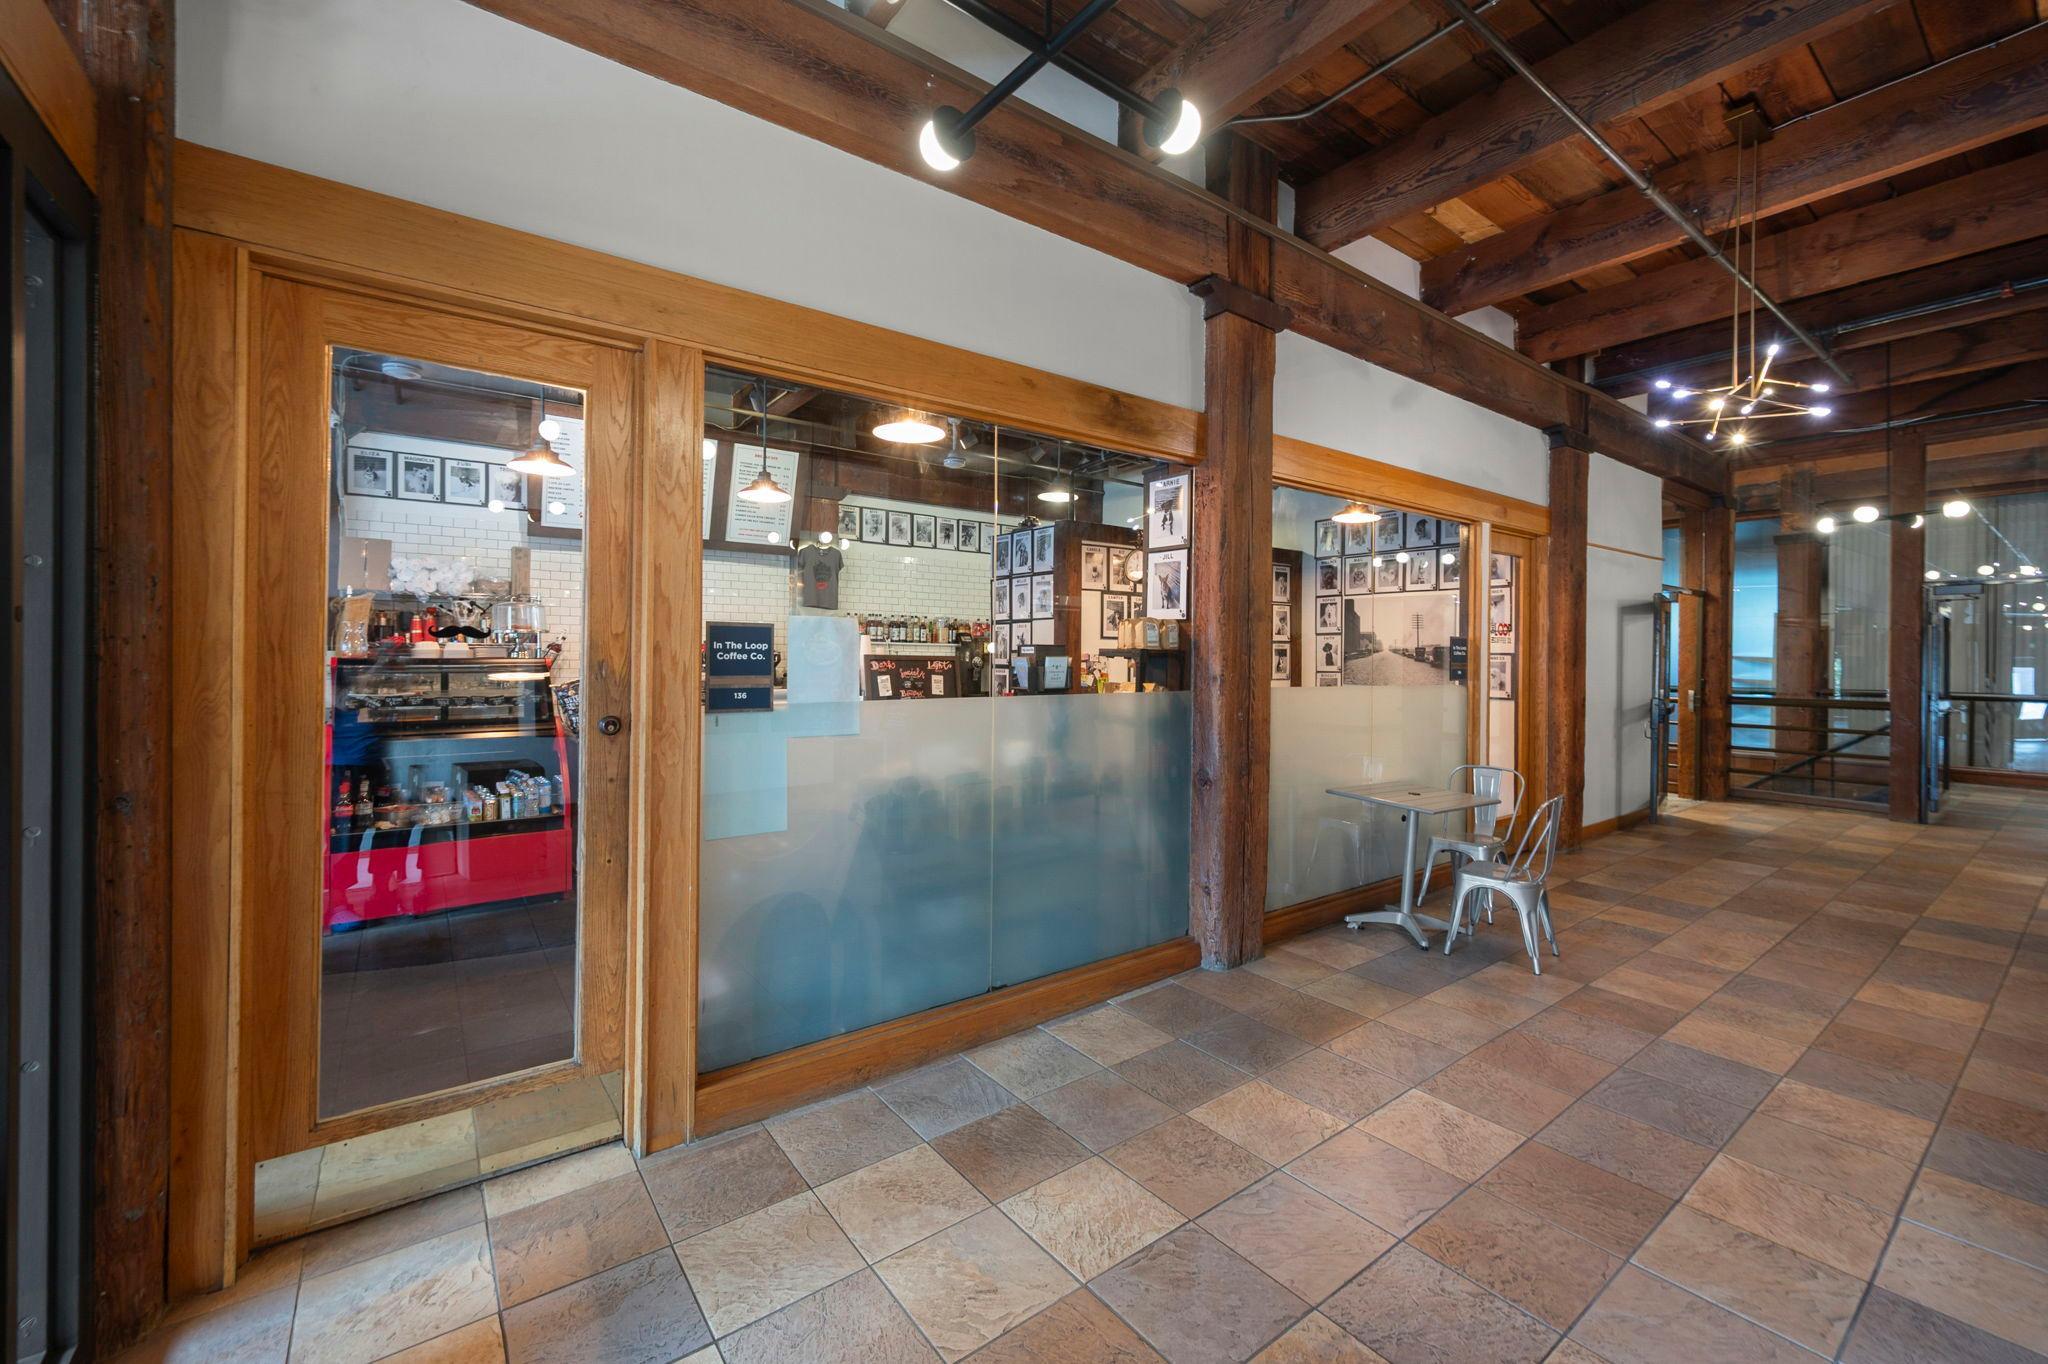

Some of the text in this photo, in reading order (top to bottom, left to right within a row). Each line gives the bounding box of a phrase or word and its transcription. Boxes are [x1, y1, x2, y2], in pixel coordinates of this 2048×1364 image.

[1158, 478, 1180, 487] ARNIE
[713, 641, 768, 650] In The Loop
[716, 652, 766, 660] Coffee Co.
